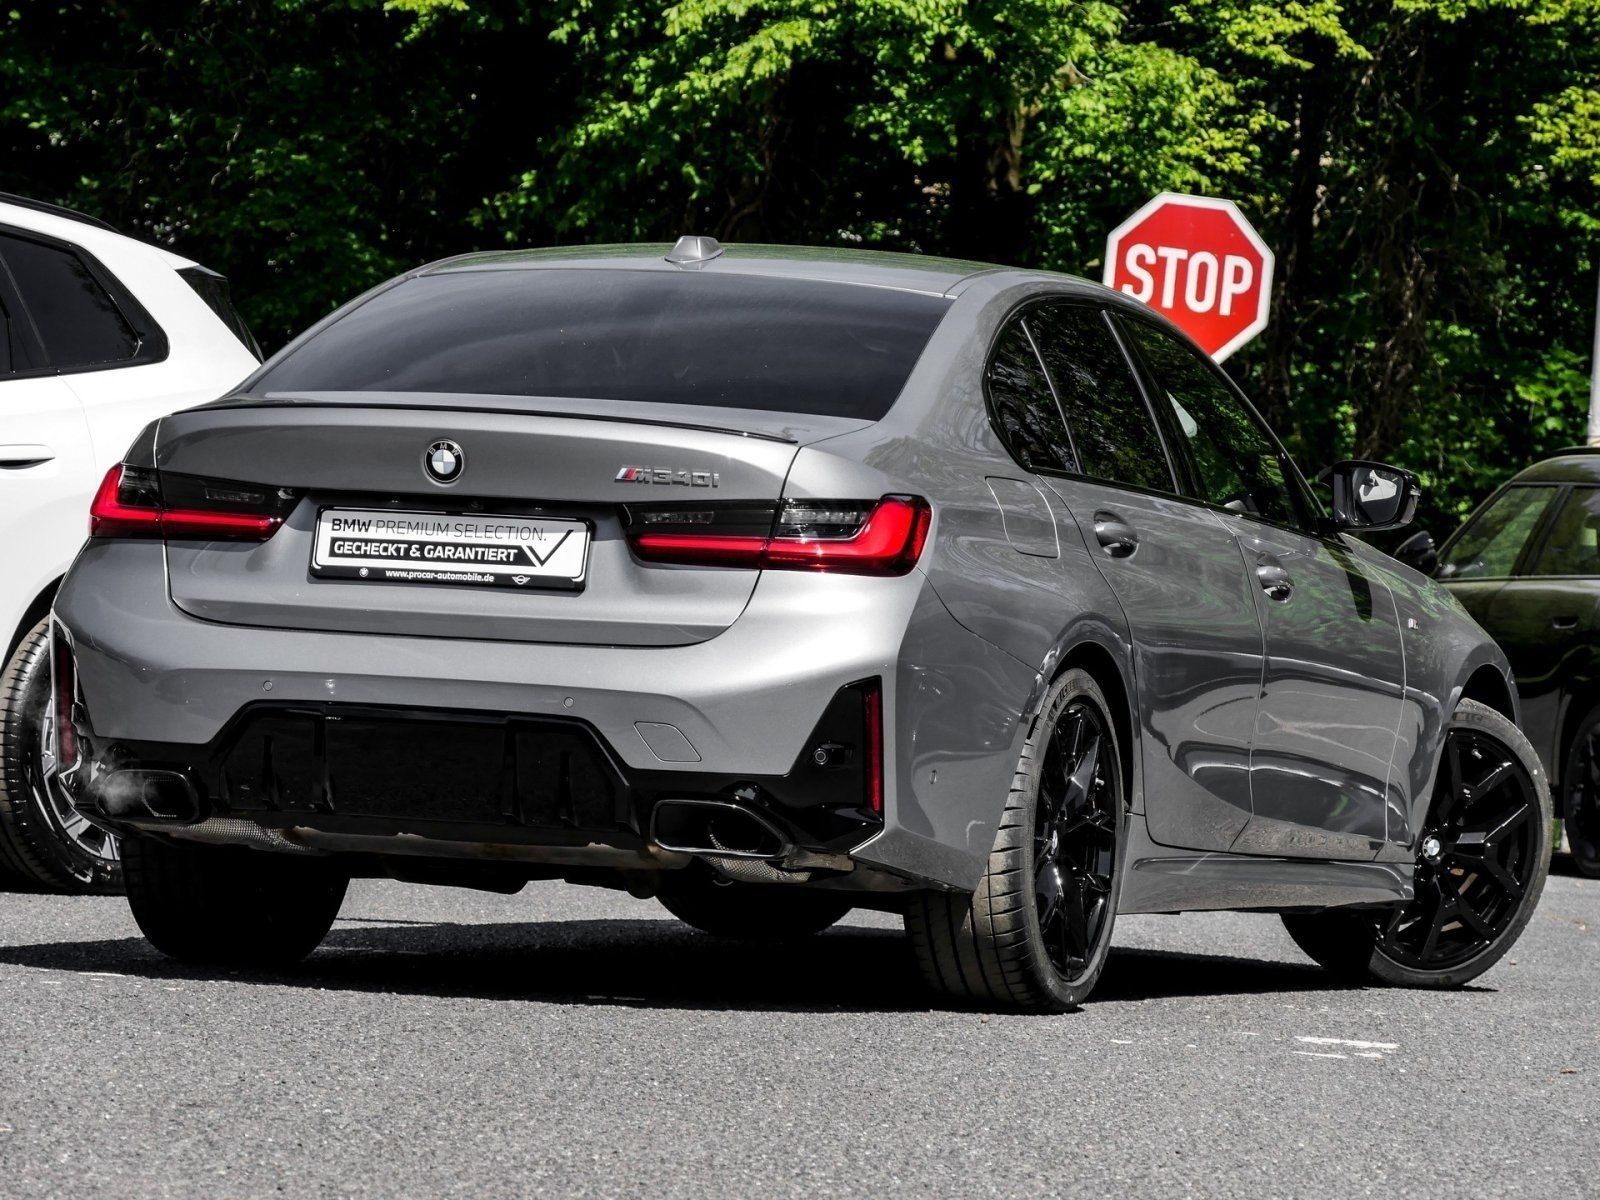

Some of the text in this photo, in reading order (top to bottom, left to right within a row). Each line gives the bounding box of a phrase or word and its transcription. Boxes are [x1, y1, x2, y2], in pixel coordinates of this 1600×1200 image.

[1121, 243, 1254, 317] STOP
[331, 518, 547, 542] BMW PREMIUM SELECTION.
[333, 540, 518, 562] GECHECKT & GARANTIERT
[385, 570, 495, 583] www.procar-automobile.de
